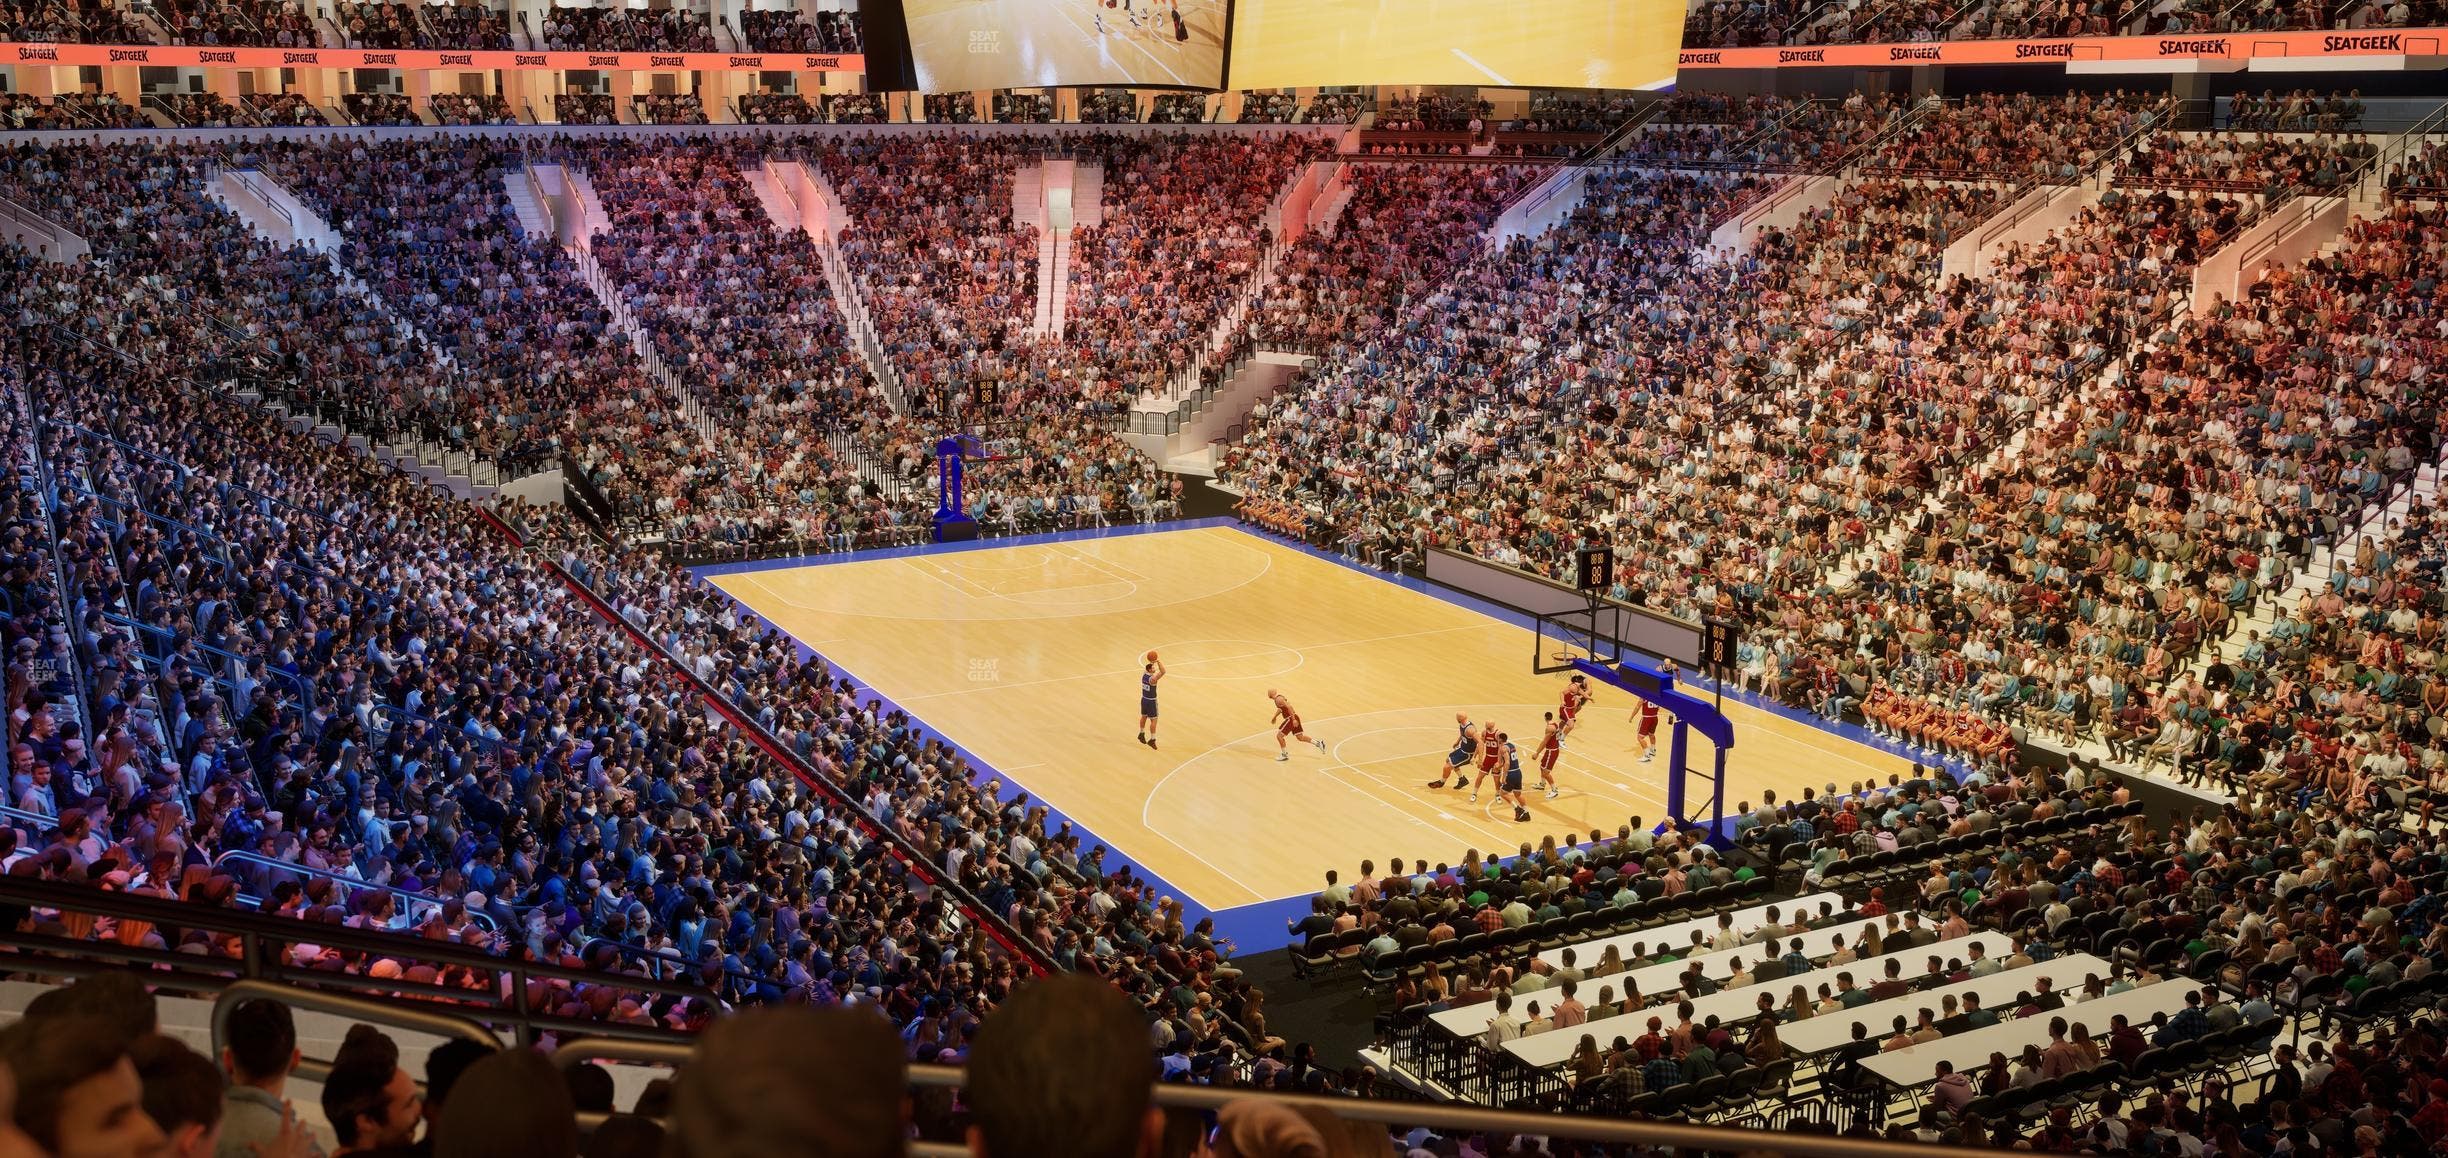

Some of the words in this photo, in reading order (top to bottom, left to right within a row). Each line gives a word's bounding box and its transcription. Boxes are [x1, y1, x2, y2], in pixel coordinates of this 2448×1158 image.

[2159, 39, 2225, 56] SEATGEEK
[2324, 34, 2401, 52] SEATGEEK
[19, 47, 58, 61] SEATGEEK
[110, 49, 148, 63] SEATGEEK
[1779, 49, 1824, 63] SEATGEEK
[1890, 46, 1941, 60] SEATGEEK
[2016, 43, 2074, 58] SEATGEEK
[200, 51, 236, 64] SEATGEEK
[284, 52, 318, 65] SEATGEEK
[364, 53, 397, 65] SEATGEEK
[440, 54, 473, 66] SEATGEEK
[516, 55, 547, 66] SEATGEEK
[589, 55, 619, 67] SEATGEEK
[651, 56, 684, 67] SEATGEEK
[730, 56, 762, 68] SEATGEEK
[806, 57, 839, 68] SEATGEEK
[1679, 52, 1721, 64] EATGEEK
